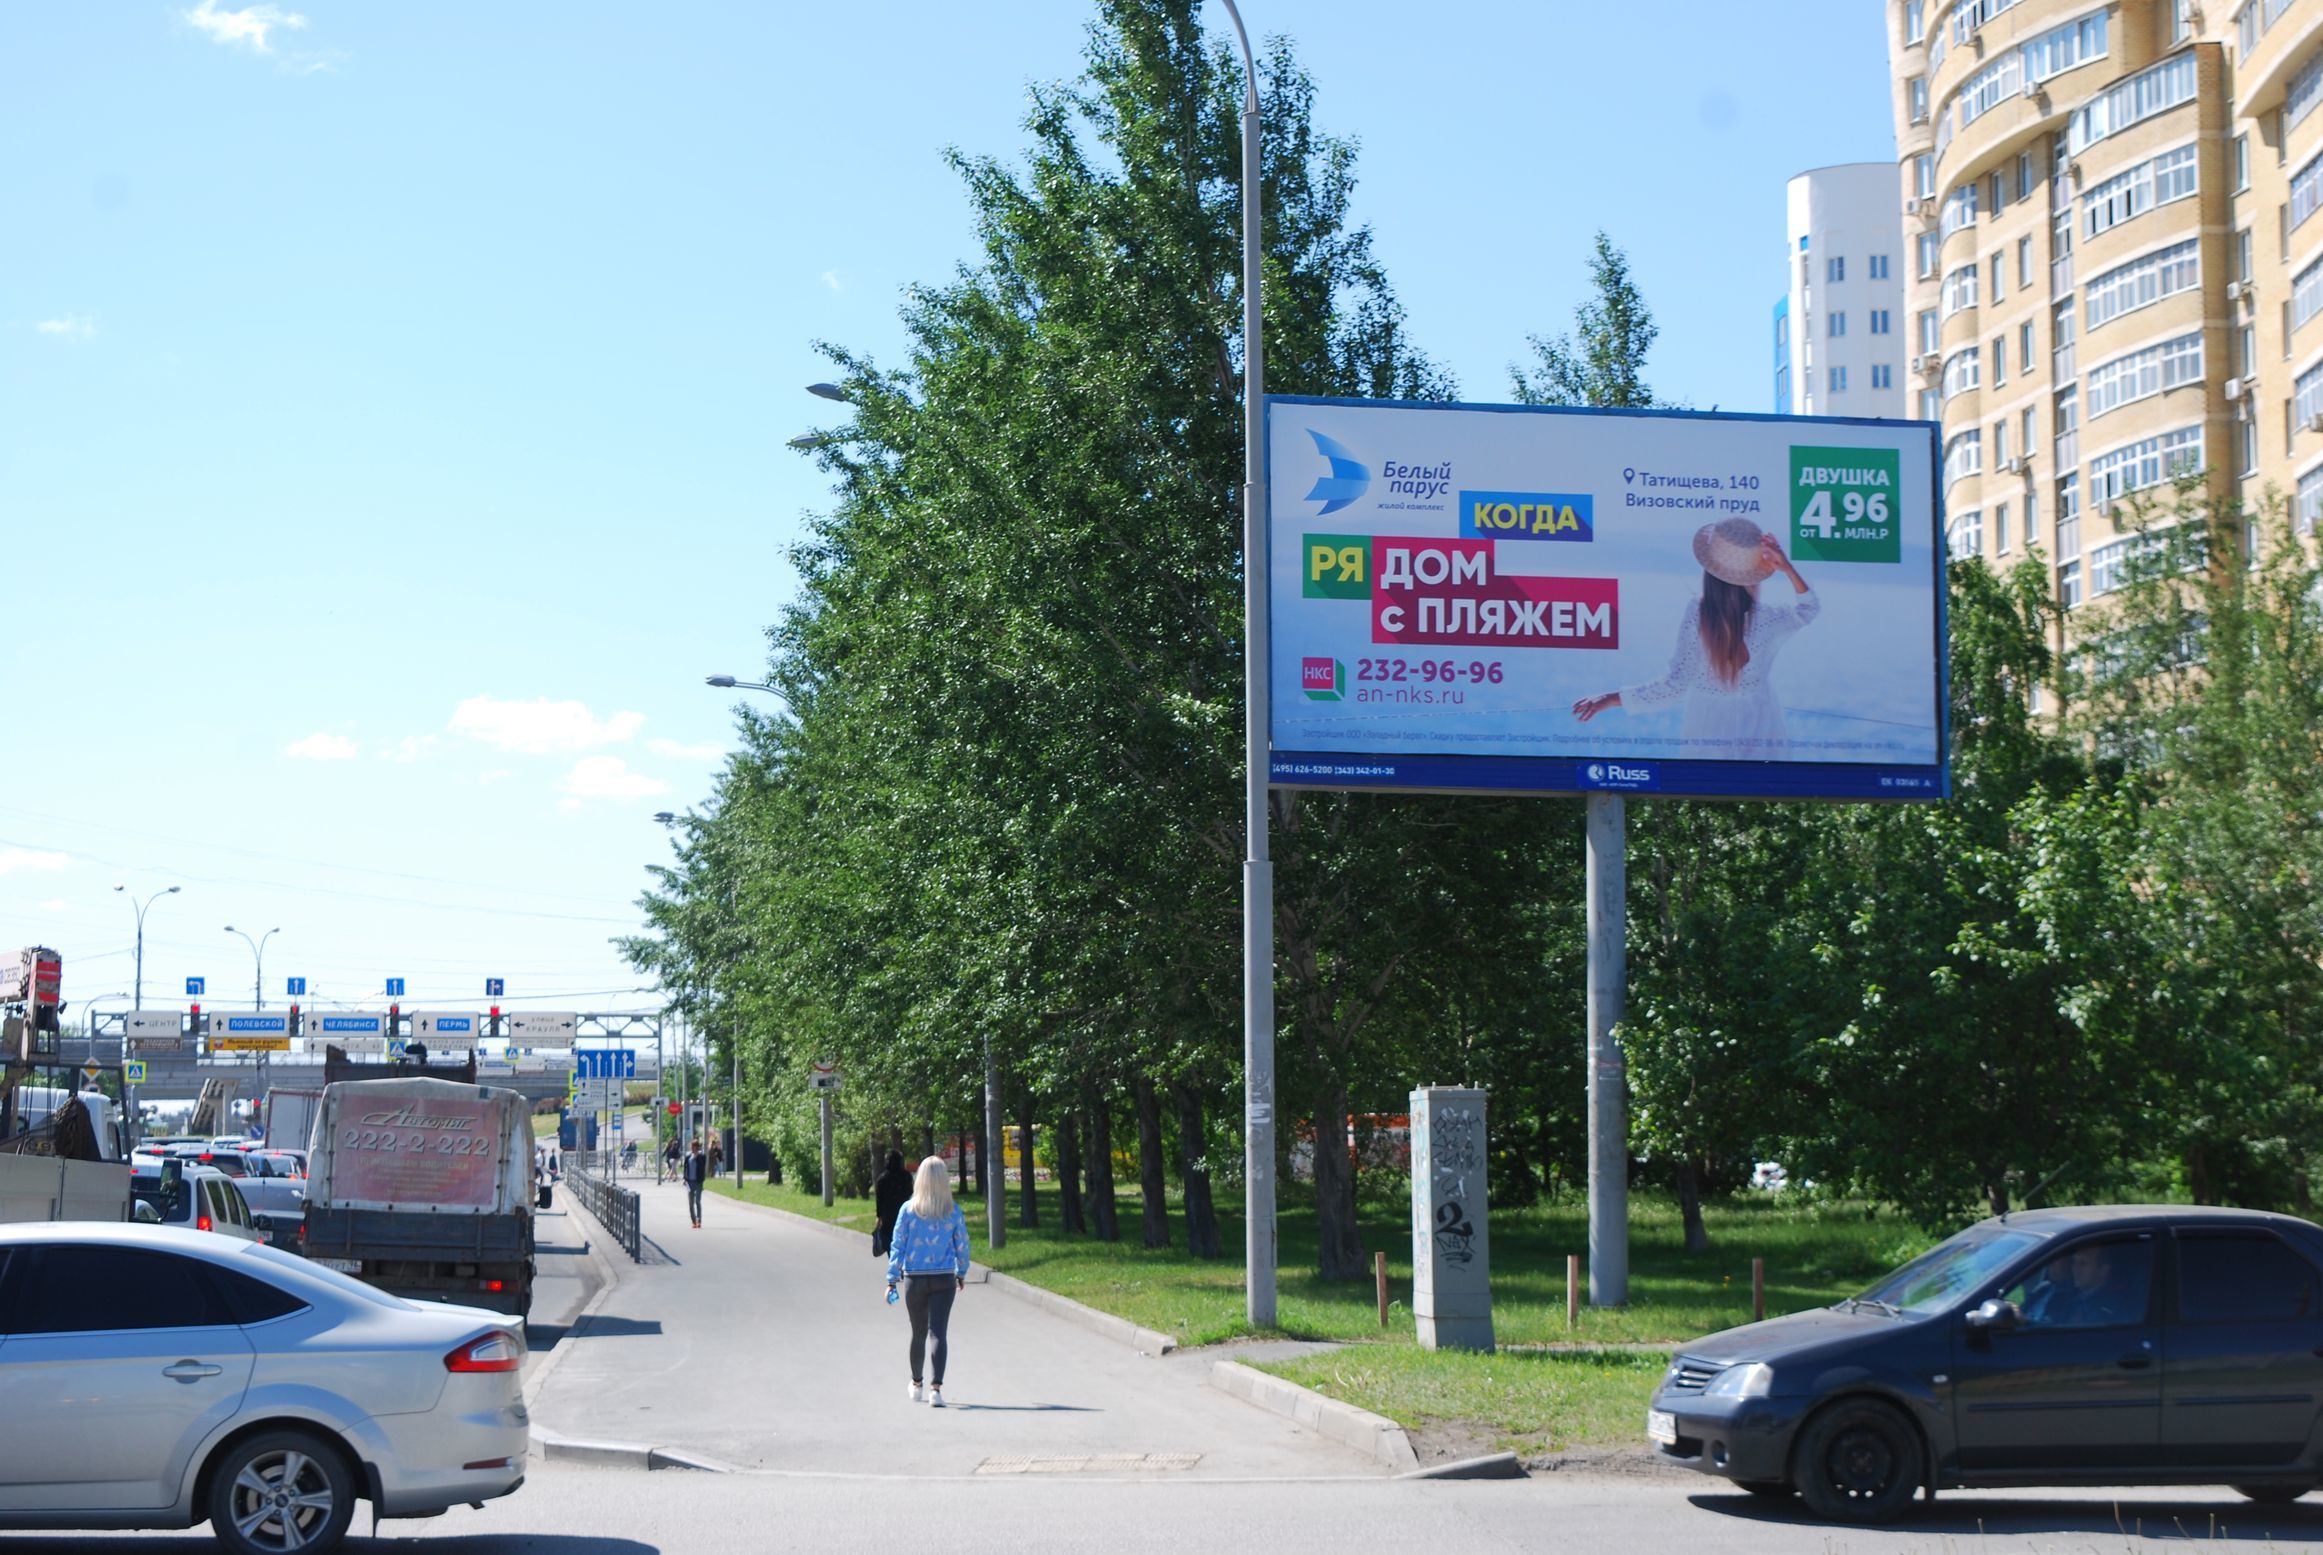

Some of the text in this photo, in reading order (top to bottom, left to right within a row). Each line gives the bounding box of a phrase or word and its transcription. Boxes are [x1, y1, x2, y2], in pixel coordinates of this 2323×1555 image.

[1383, 461, 1452, 479] Белый
[1798, 467, 1890, 487] ДВУШКА
[1389, 480, 1449, 499] парус
[1639, 472, 1760, 491] Татищева, 140
[1377, 502, 1405, 511] жилой
[1625, 493, 1760, 513] Визовский пруд
[1474, 502, 1579, 535] КОГДА
[1800, 529, 1816, 538] от
[1311, 546, 1487, 590] РЯ ДОМ
[1380, 597, 1611, 638] с ПЛЯЖЕМ
[1304, 666, 1332, 680] НКС
[1357, 658, 1504, 684] 232-96-96
[1357, 686, 1465, 705] an-nks.ru
[1295, 765, 1333, 774] 626-5200
[1608, 765, 1651, 781] Russ
[231, 1018, 284, 1029] ПОЛЕВСКОЙ
[325, 1020, 377, 1030] ЧЕЛЯБИНСК
[438, 1019, 468, 1030] ПЕРМЬ
[344, 1129, 490, 1157] 222-2-222
